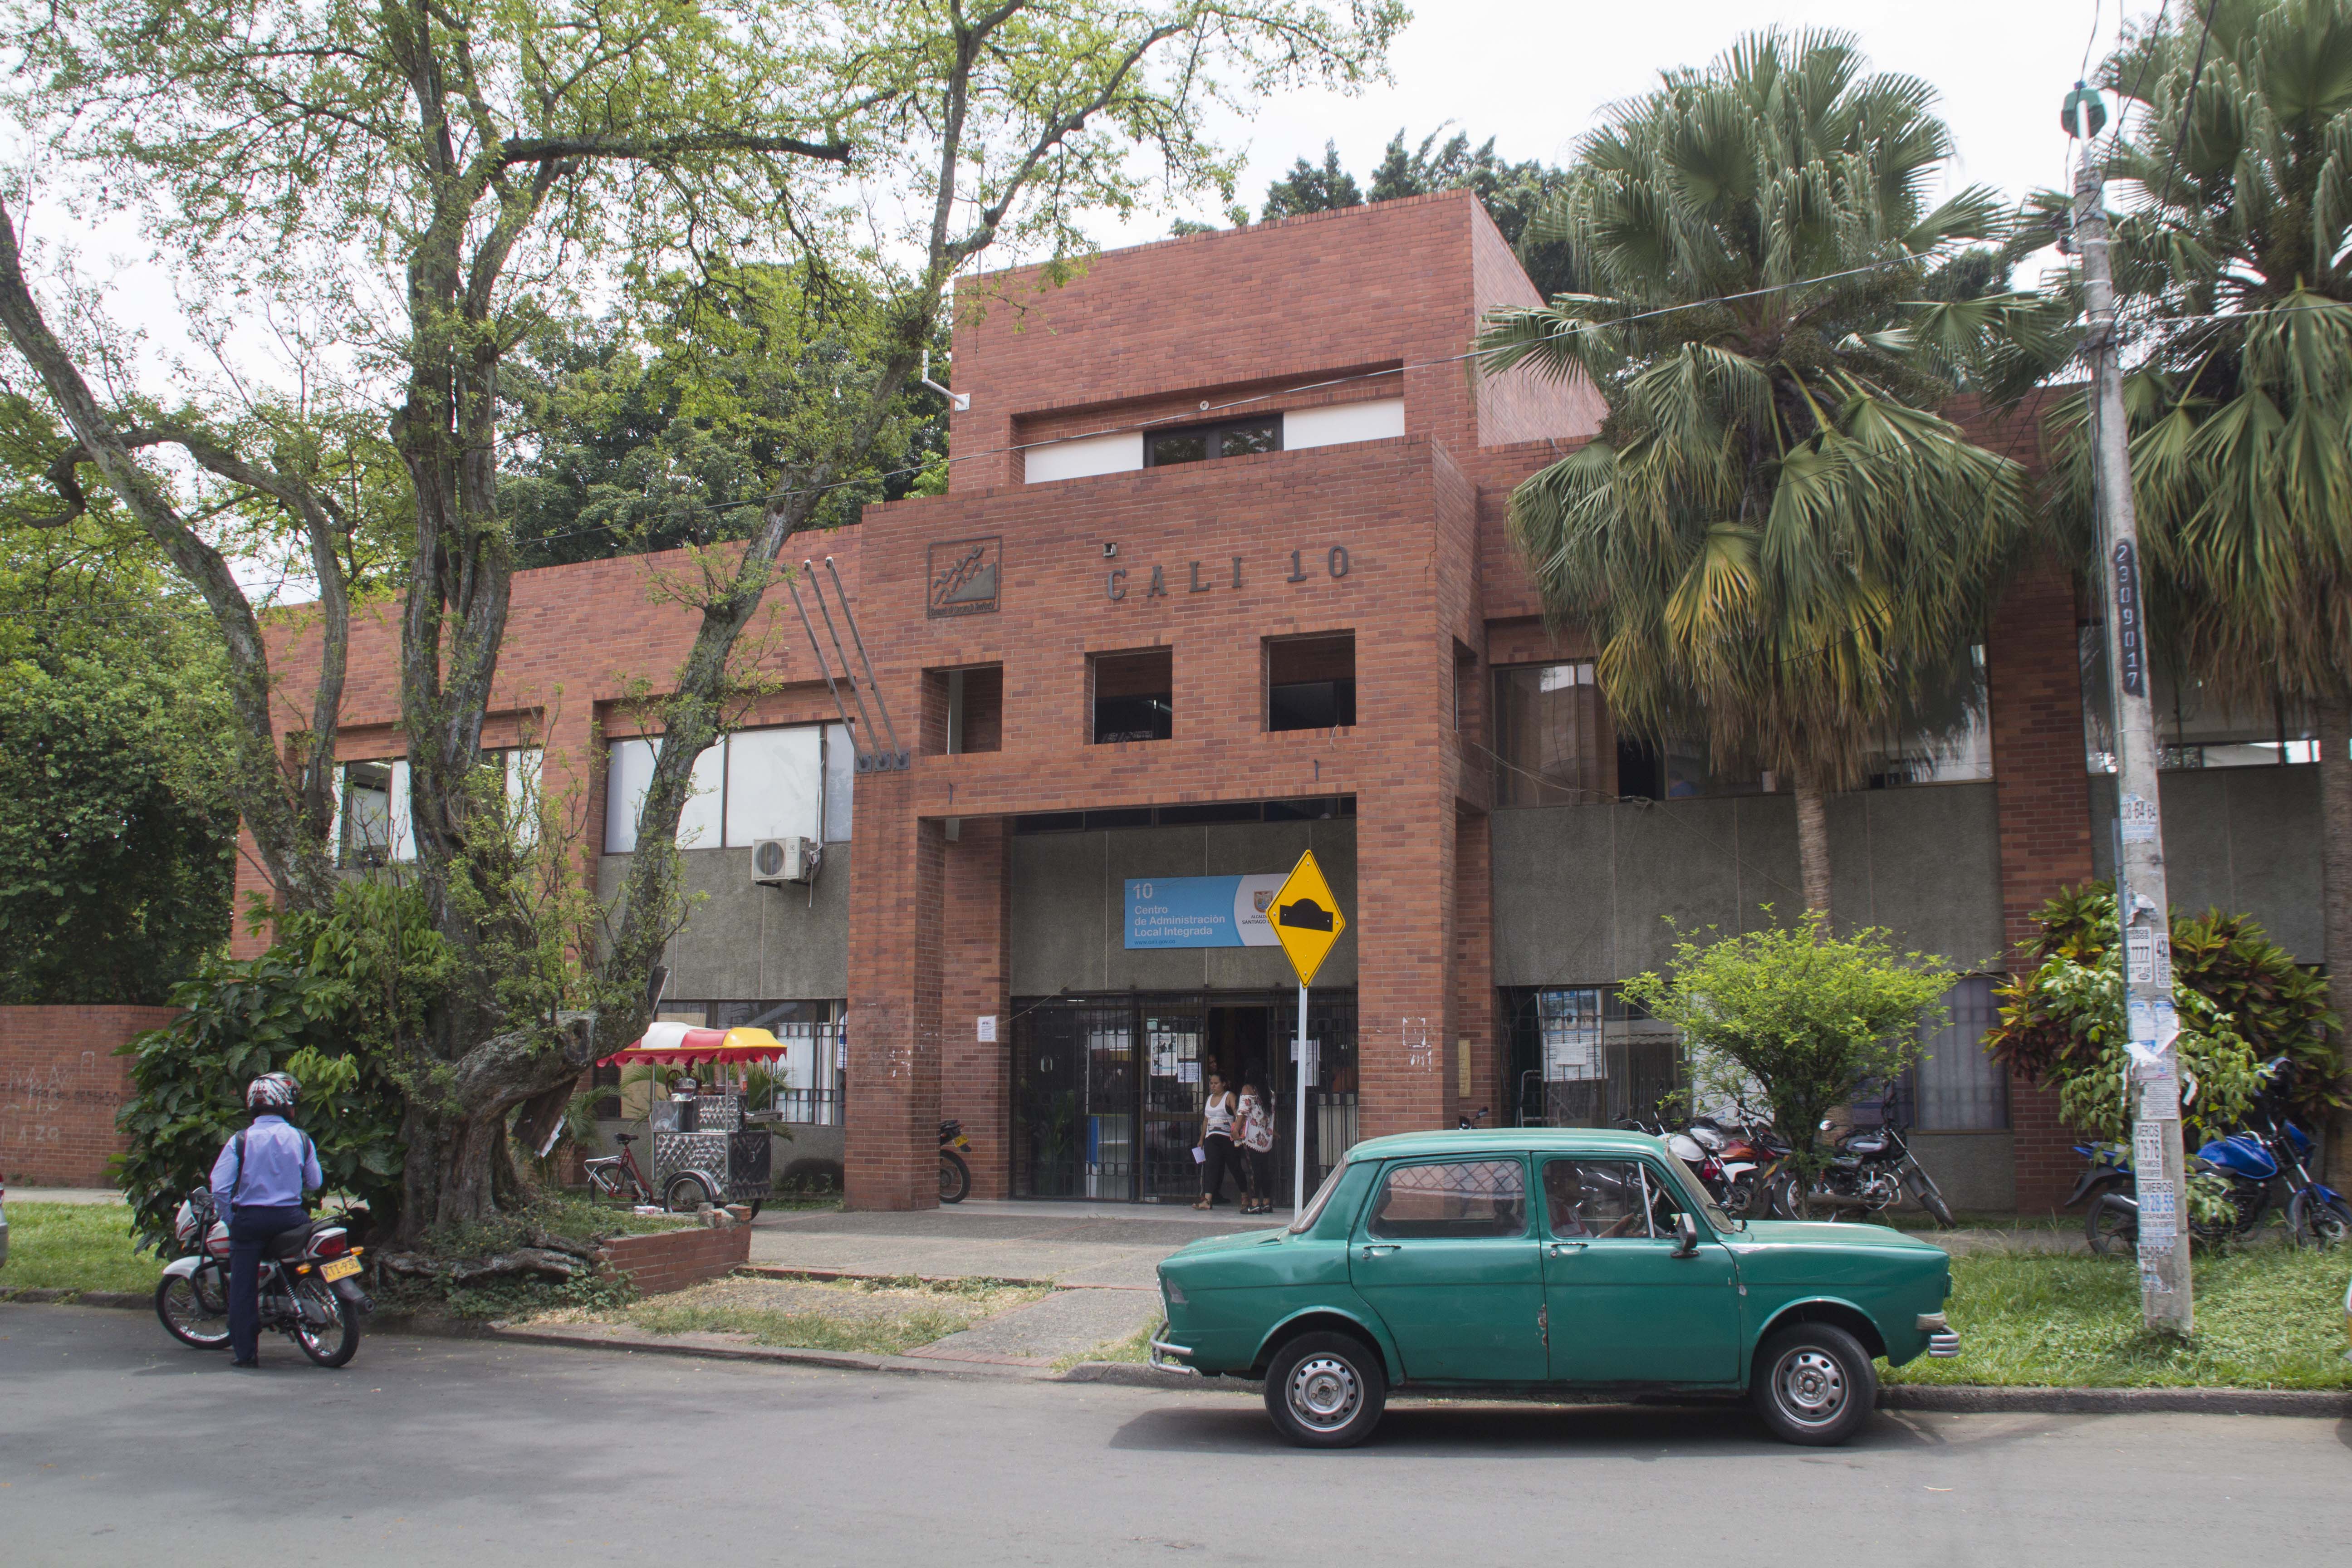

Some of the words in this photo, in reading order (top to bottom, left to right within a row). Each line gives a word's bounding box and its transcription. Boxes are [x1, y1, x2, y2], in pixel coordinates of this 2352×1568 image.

[1107, 557, 1242, 600] CALI
[1287, 546, 1348, 583] 10
[2117, 544, 2138, 687] 2309017
[1133, 883, 1153, 899] 10
[1135, 905, 1168, 915] Centro
[1135, 917, 1147, 926] de
[1150, 914, 1225, 925] Administración
[1135, 927, 1161, 937] Local
[1165, 926, 1212, 937] Integrada
